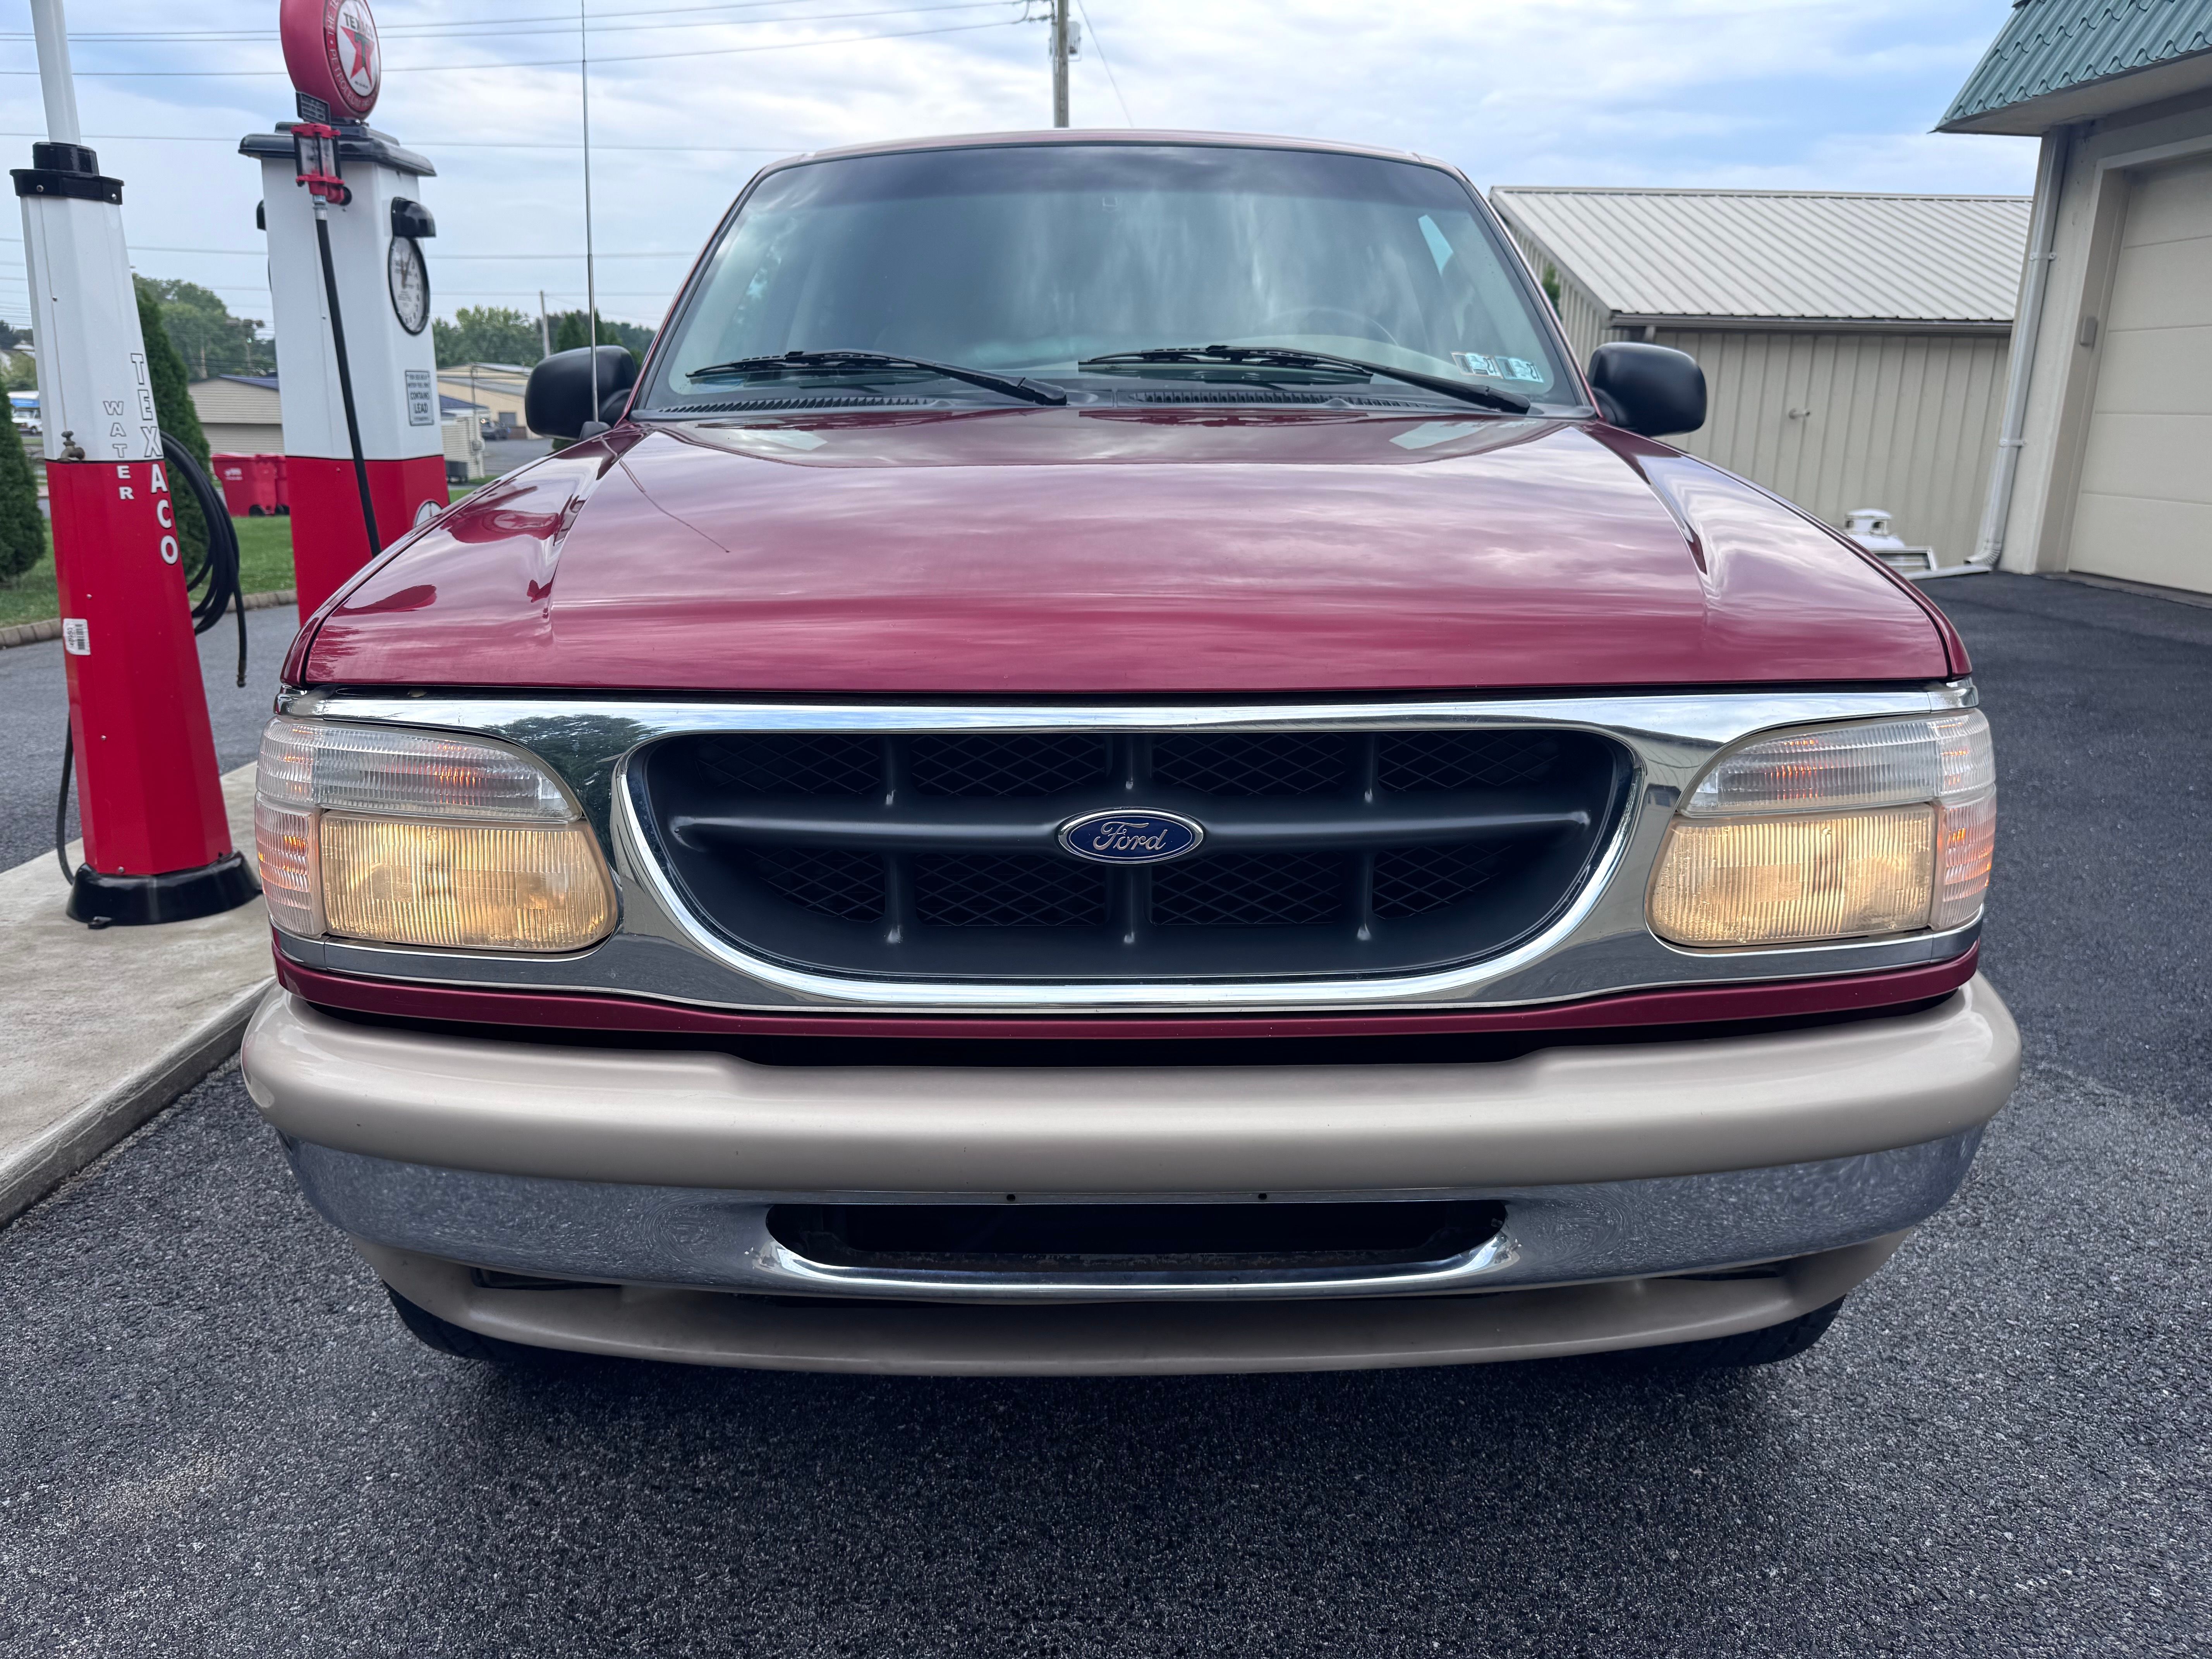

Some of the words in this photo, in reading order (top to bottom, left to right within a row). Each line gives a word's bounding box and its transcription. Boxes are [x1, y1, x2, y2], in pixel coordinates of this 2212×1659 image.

[410, 391, 430, 400] CONTAINS
[414, 402, 428, 414] LEAD
[103, 401, 134, 500] WATER
[131, 353, 179, 565] TEXACO
[1092, 821, 1168, 851] Ford
